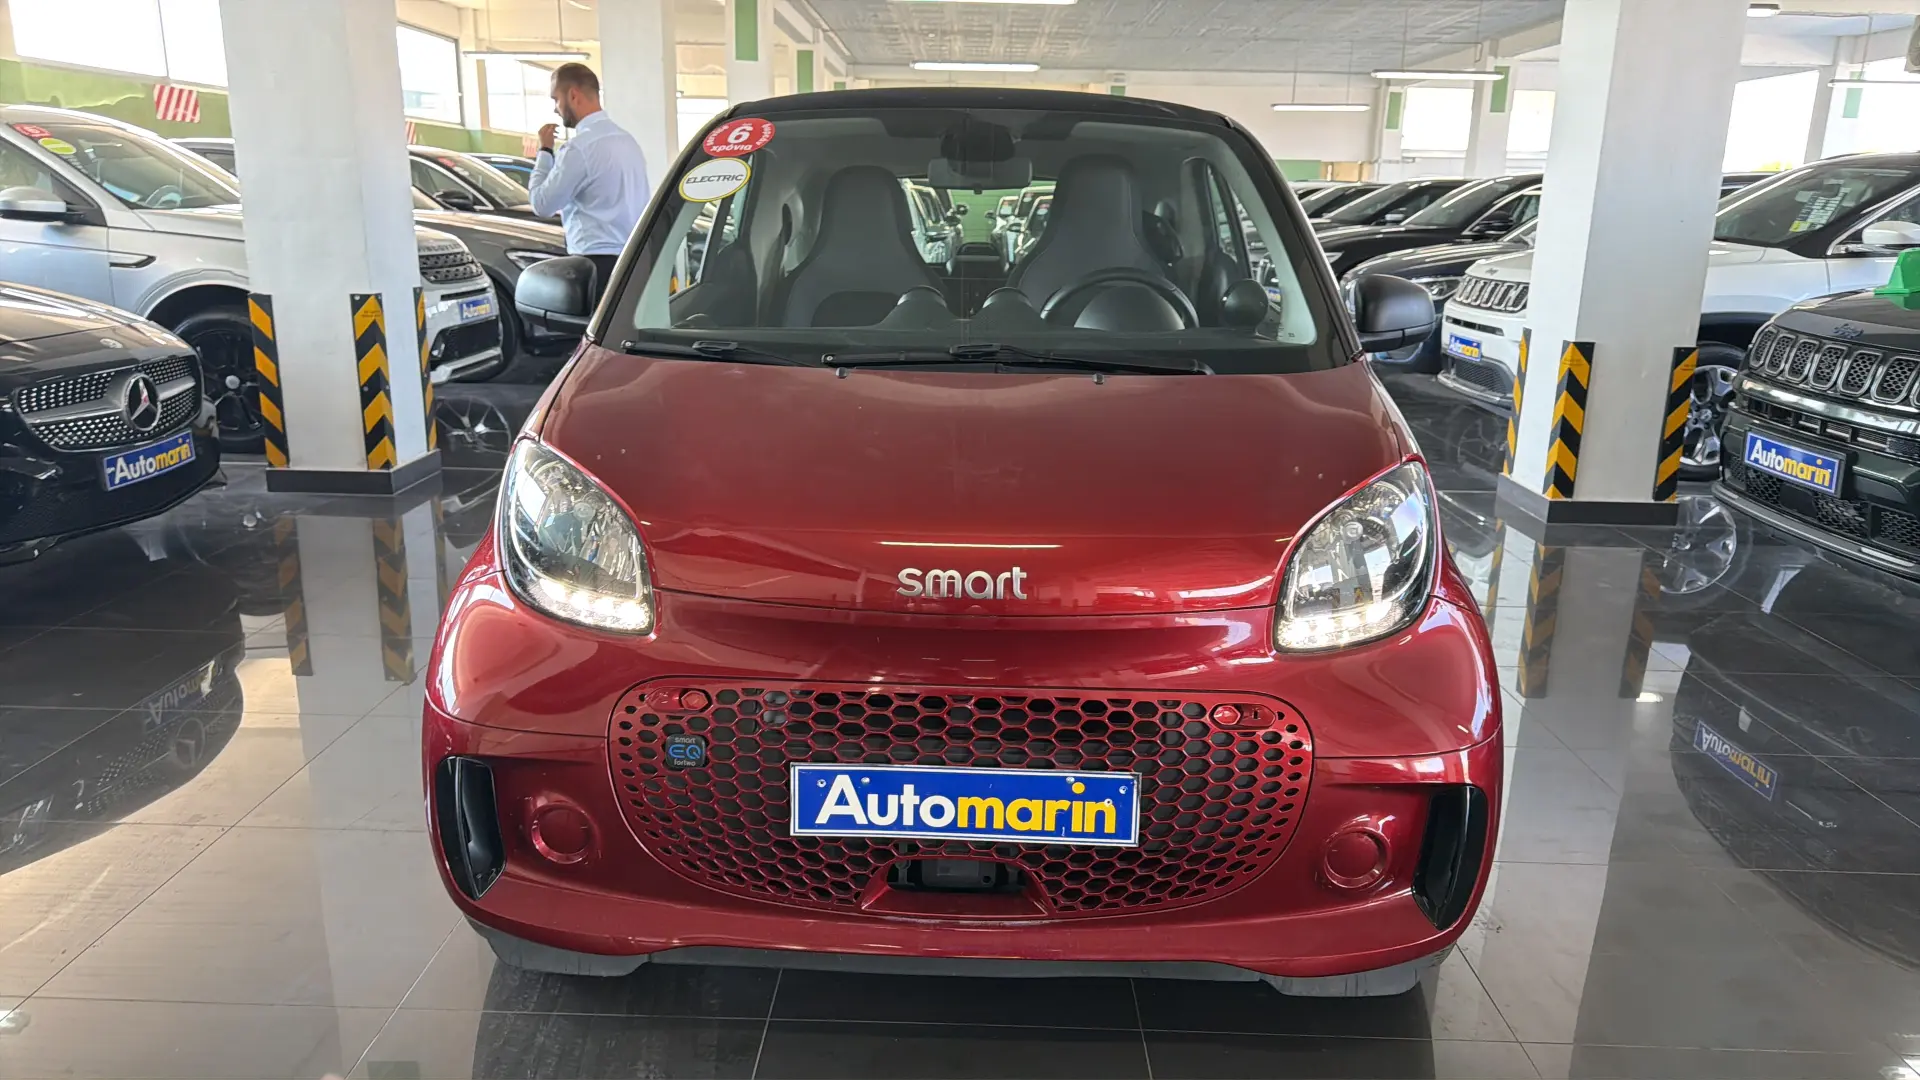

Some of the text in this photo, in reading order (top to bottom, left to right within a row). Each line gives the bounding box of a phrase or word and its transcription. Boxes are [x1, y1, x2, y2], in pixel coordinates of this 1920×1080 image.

[727, 126, 753, 144] 6
[685, 174, 744, 184] ELECTRIC
[114, 438, 191, 484] Automarin
[1750, 439, 1831, 487] Automarin
[897, 566, 1028, 600] smart
[674, 736, 696, 744] smart
[669, 744, 700, 759] EQ
[674, 758, 696, 767] fortwo
[814, 774, 1116, 834] Automarin
